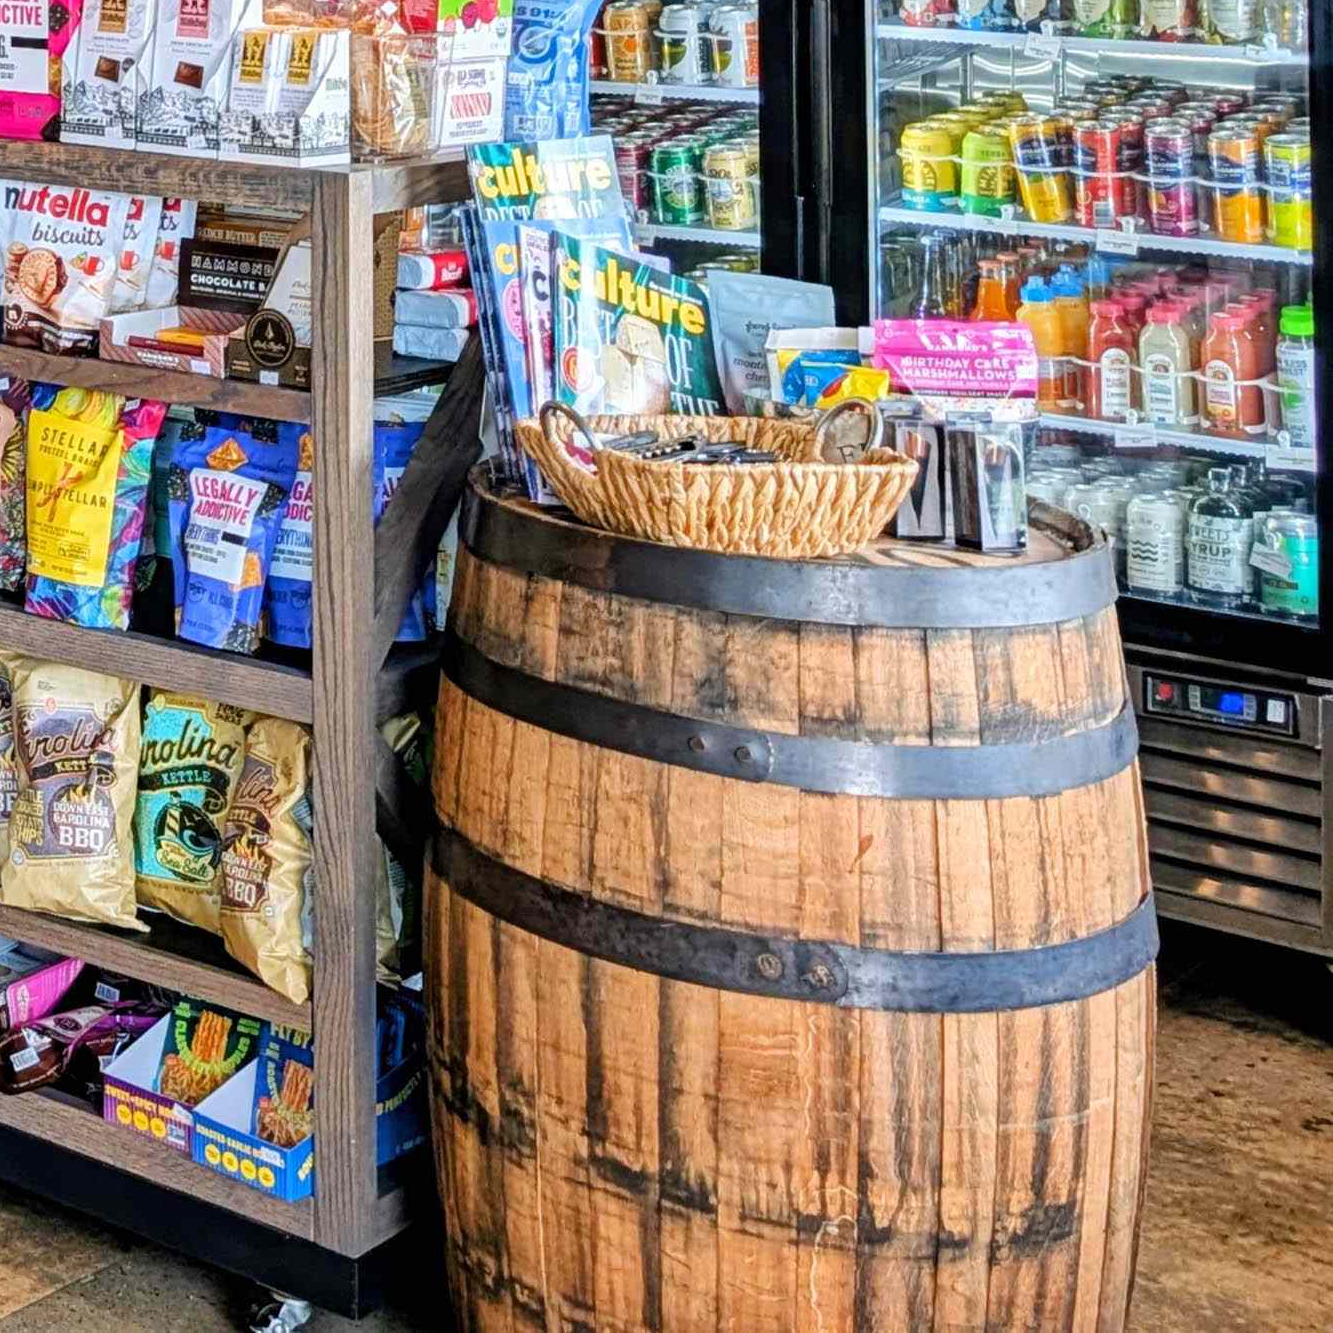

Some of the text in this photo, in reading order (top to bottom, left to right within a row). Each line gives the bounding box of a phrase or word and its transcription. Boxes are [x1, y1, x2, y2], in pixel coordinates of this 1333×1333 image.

[478, 148, 611, 199] culture
[3, 182, 111, 228] nutella
[31, 222, 107, 248] biscuits
[189, 271, 253, 290] CHOCOLATE
[901, 355, 971, 369] BIRTHDAY
[902, 367, 1016, 381] MARSHMALLOWS
[40, 426, 110, 458] STELLAR
[194, 475, 260, 507] LEGALLY
[194, 501, 251, 526] ADDICTIVE
[160, 769, 213, 786] KETTLE
[52, 800, 109, 817] DOWN EAST
[53, 812, 110, 830] CAROLINA
[58, 825, 106, 851] BBQ
